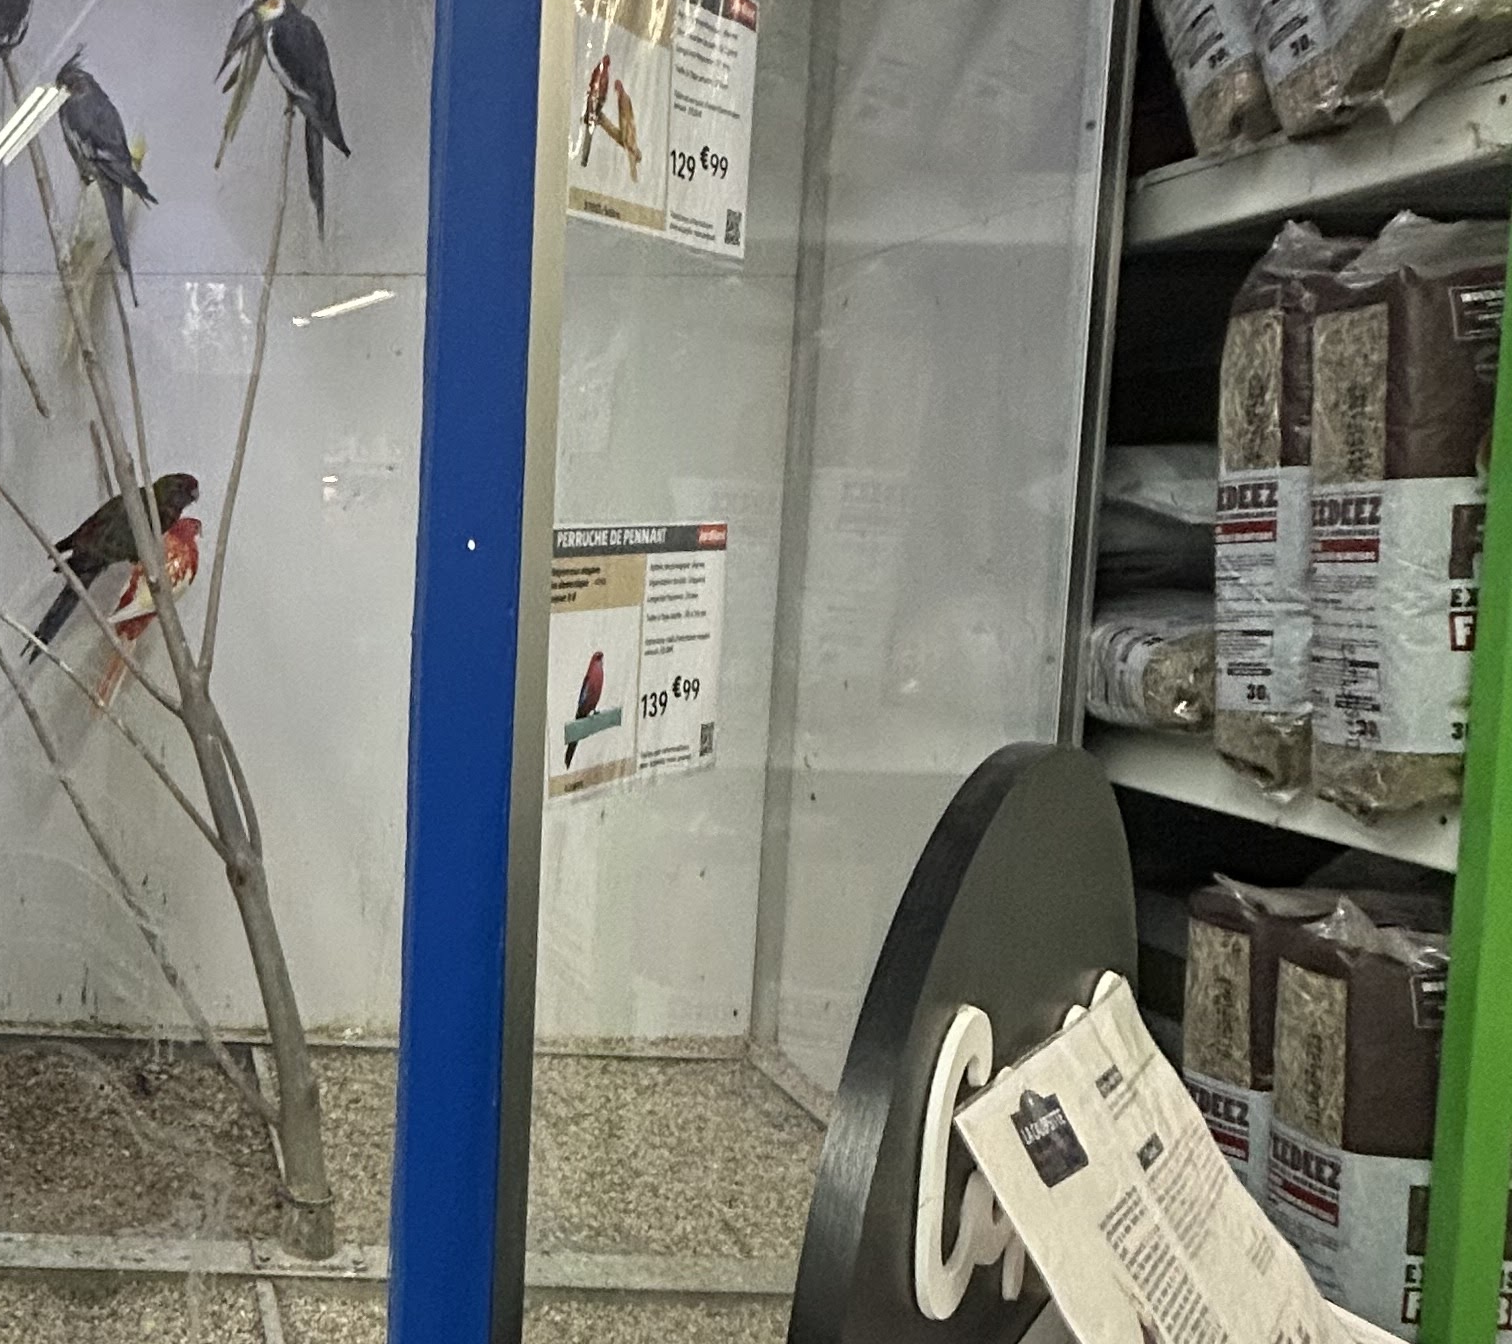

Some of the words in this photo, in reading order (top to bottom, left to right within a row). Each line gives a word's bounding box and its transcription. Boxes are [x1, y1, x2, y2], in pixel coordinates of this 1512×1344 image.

[670, 149, 696, 182] 129
[556, 529, 609, 548] PERRUCHE
[609, 529, 623, 546] DE
[641, 690, 669, 719] 139
[672, 675, 700, 701] €99
